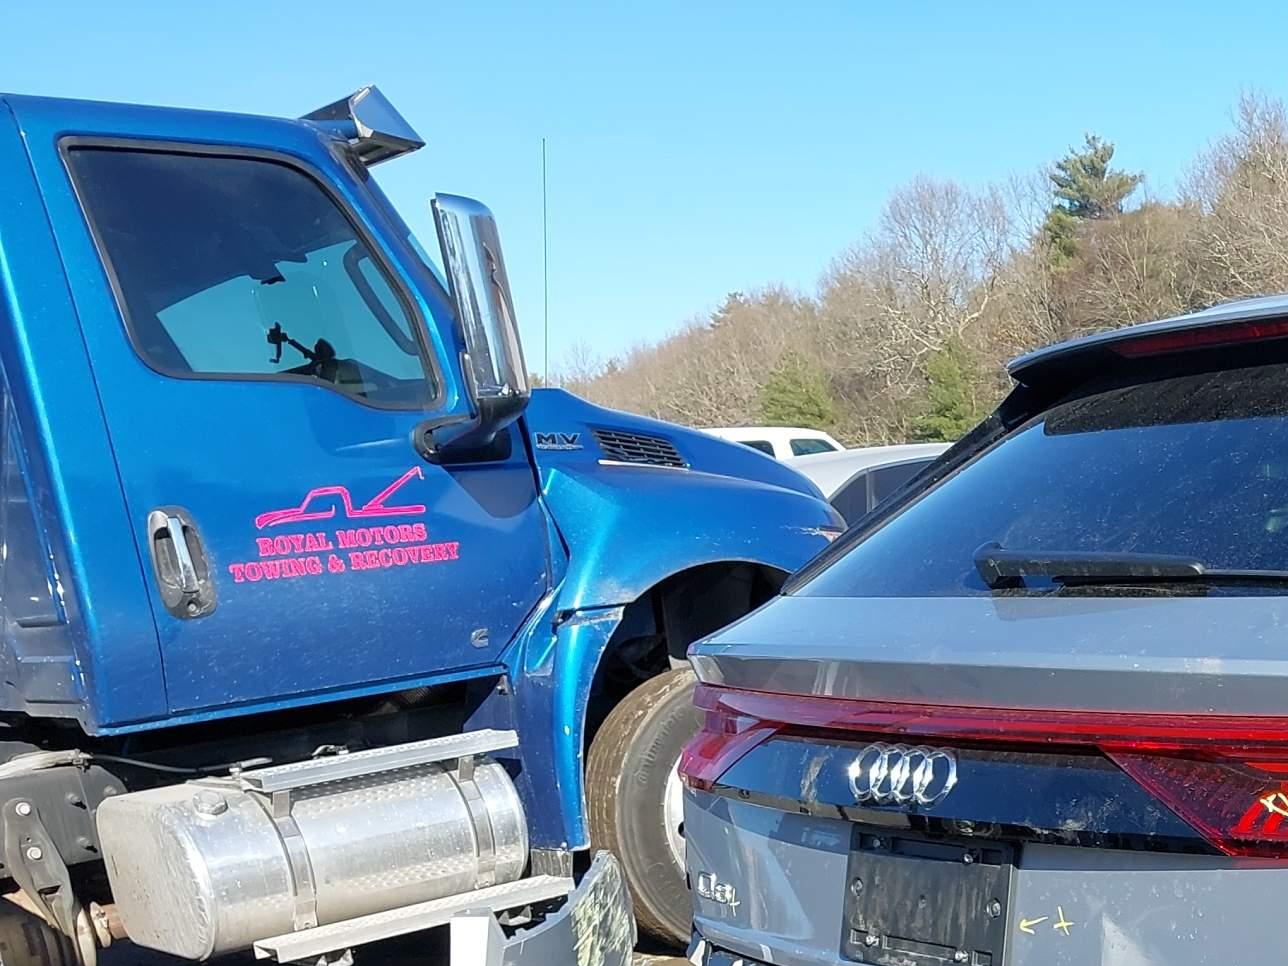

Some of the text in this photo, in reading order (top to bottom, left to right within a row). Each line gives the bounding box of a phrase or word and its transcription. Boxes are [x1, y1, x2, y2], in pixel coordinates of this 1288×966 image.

[535, 432, 580, 445] MV
[256, 523, 428, 556] ROYAL MOTORS
[229, 542, 459, 583] TOWING & RECOVERY
